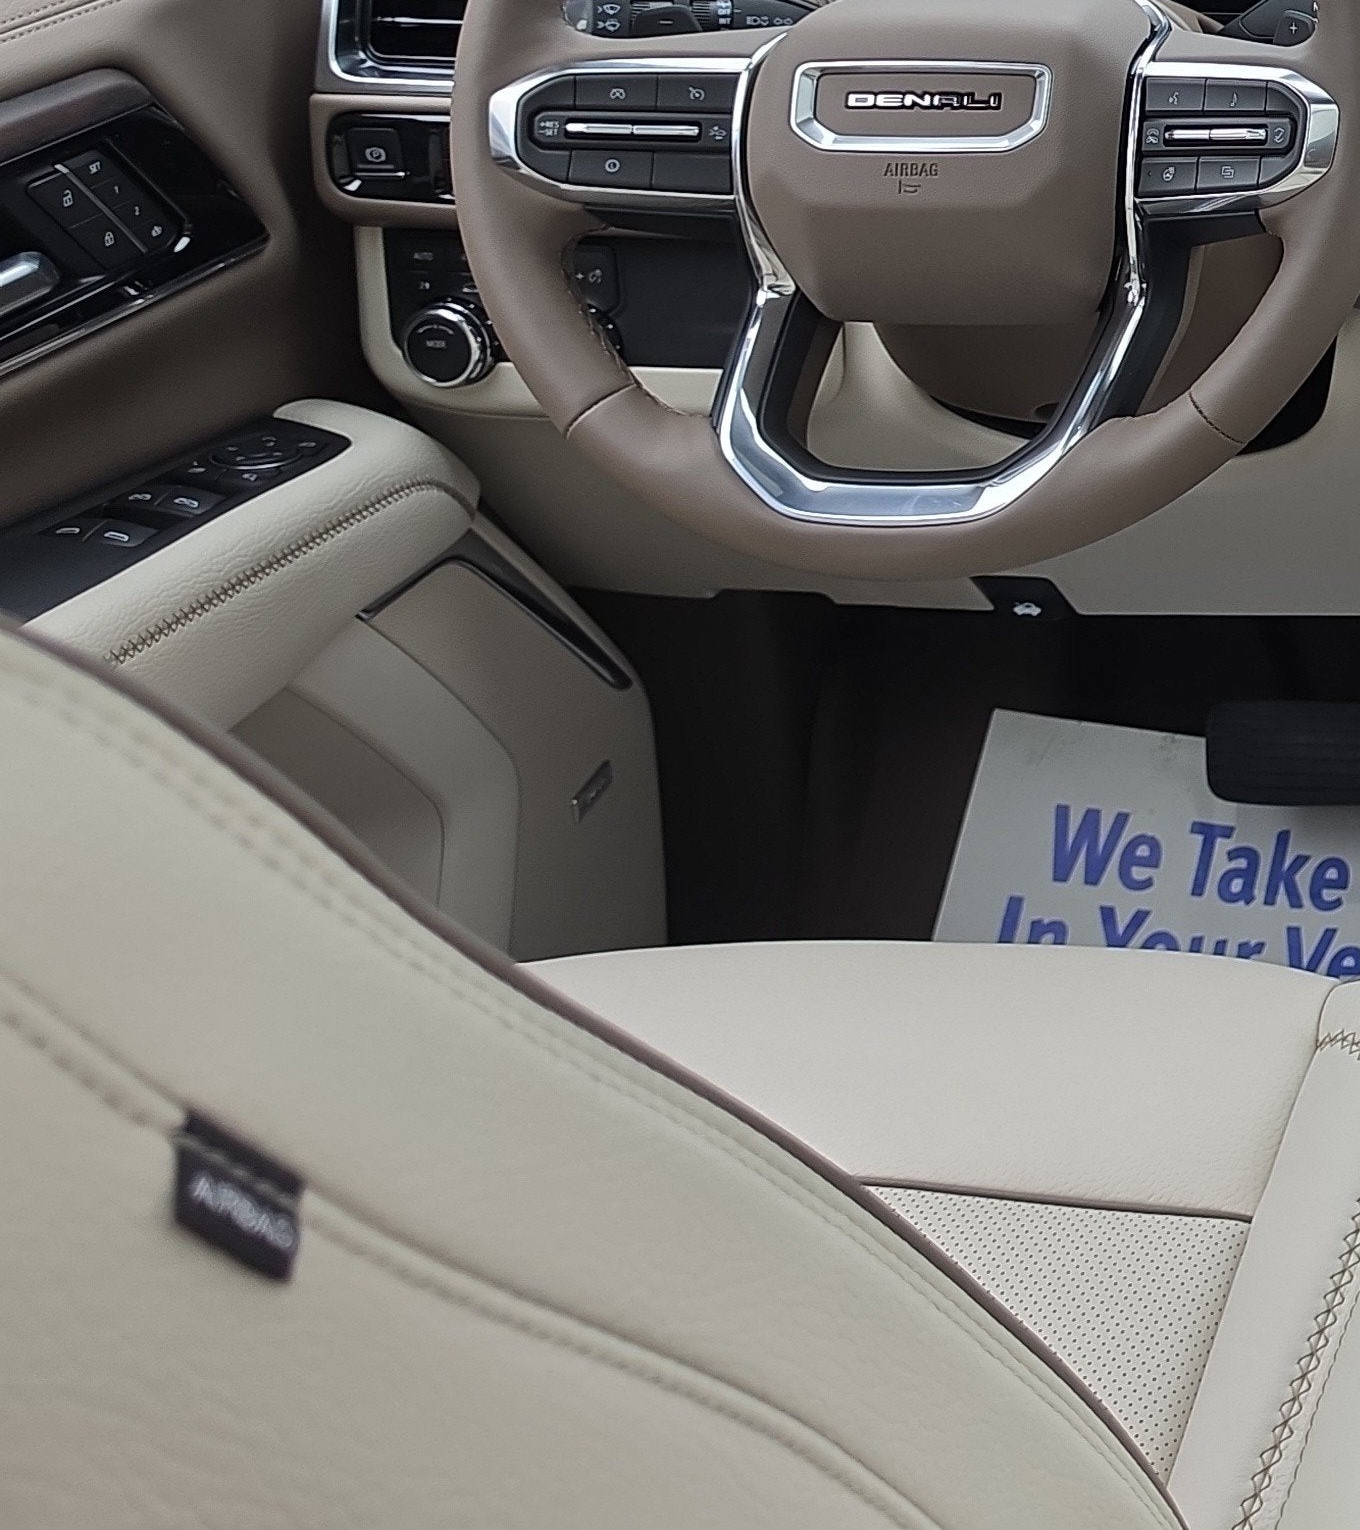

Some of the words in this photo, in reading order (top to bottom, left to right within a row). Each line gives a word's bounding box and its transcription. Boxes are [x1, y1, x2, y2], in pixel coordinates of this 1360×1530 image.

[845, 91, 1003, 111] DENALI
[883, 162, 939, 178] AIRBAG
[1051, 803, 1163, 893] We
[1188, 821, 1352, 913] Take
